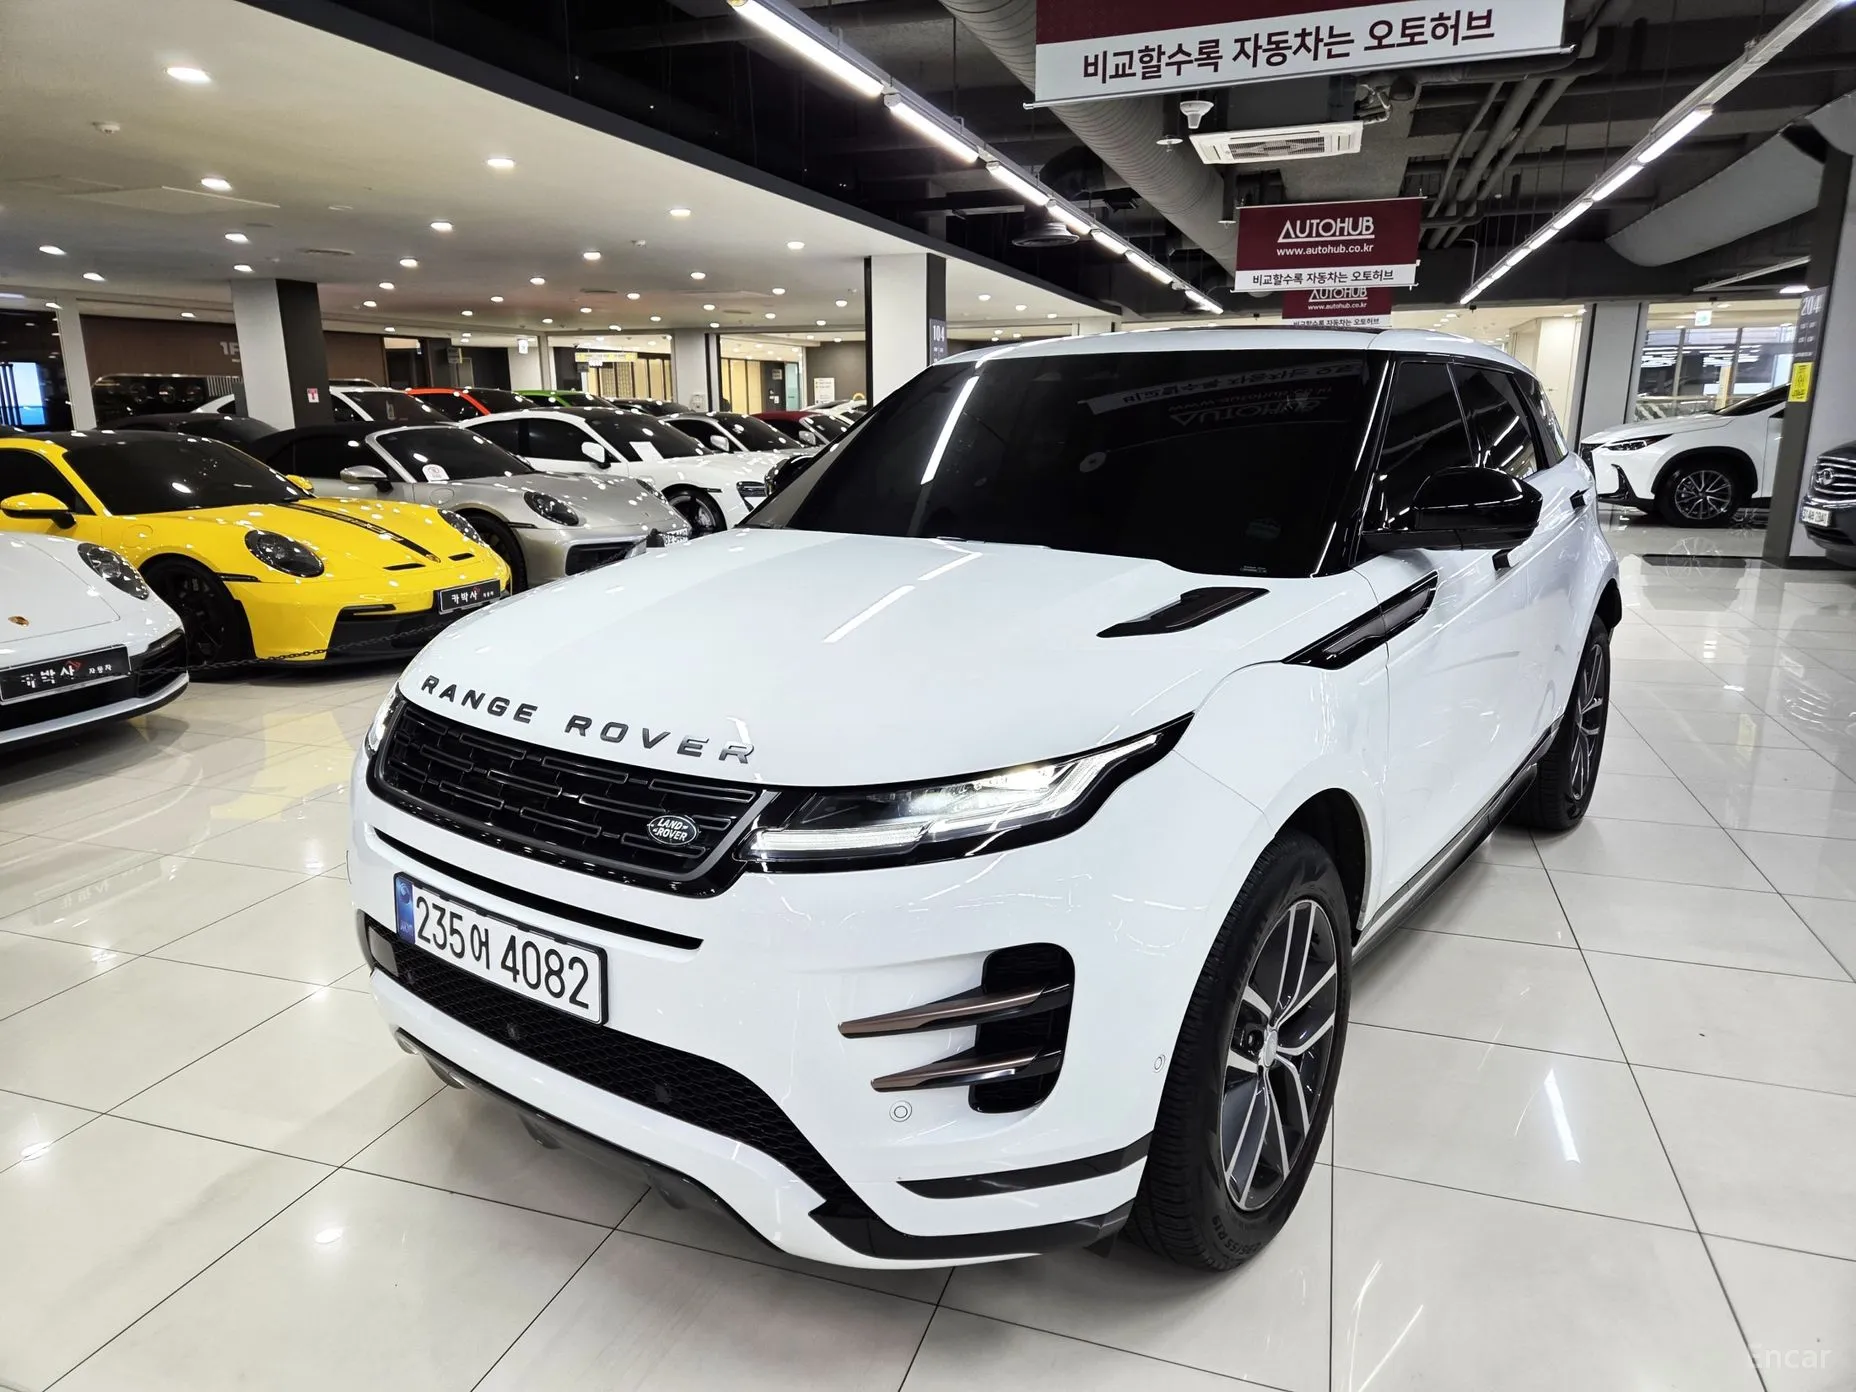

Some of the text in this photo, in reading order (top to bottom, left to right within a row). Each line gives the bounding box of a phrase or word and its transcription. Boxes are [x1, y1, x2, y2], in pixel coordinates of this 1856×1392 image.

[1083, 9, 1495, 84] 비교할수록 자동차는 오토허브
[1277, 216, 1375, 243] AUTOHUB
[1277, 243, 1374, 256] www.autohub.co.kr
[1252, 269, 1394, 286] 비교할수록 자동차는 오토허브
[1308, 288, 1368, 303] AUTOHUB
[1308, 301, 1367, 310] www.autohub.co.kr
[933, 325, 945, 342] 104
[421, 675, 755, 765] RANGE ROVER
[657, 818, 683, 830] LAND
[655, 827, 688, 842] ROVER
[415, 896, 590, 1010] 235어 4082
